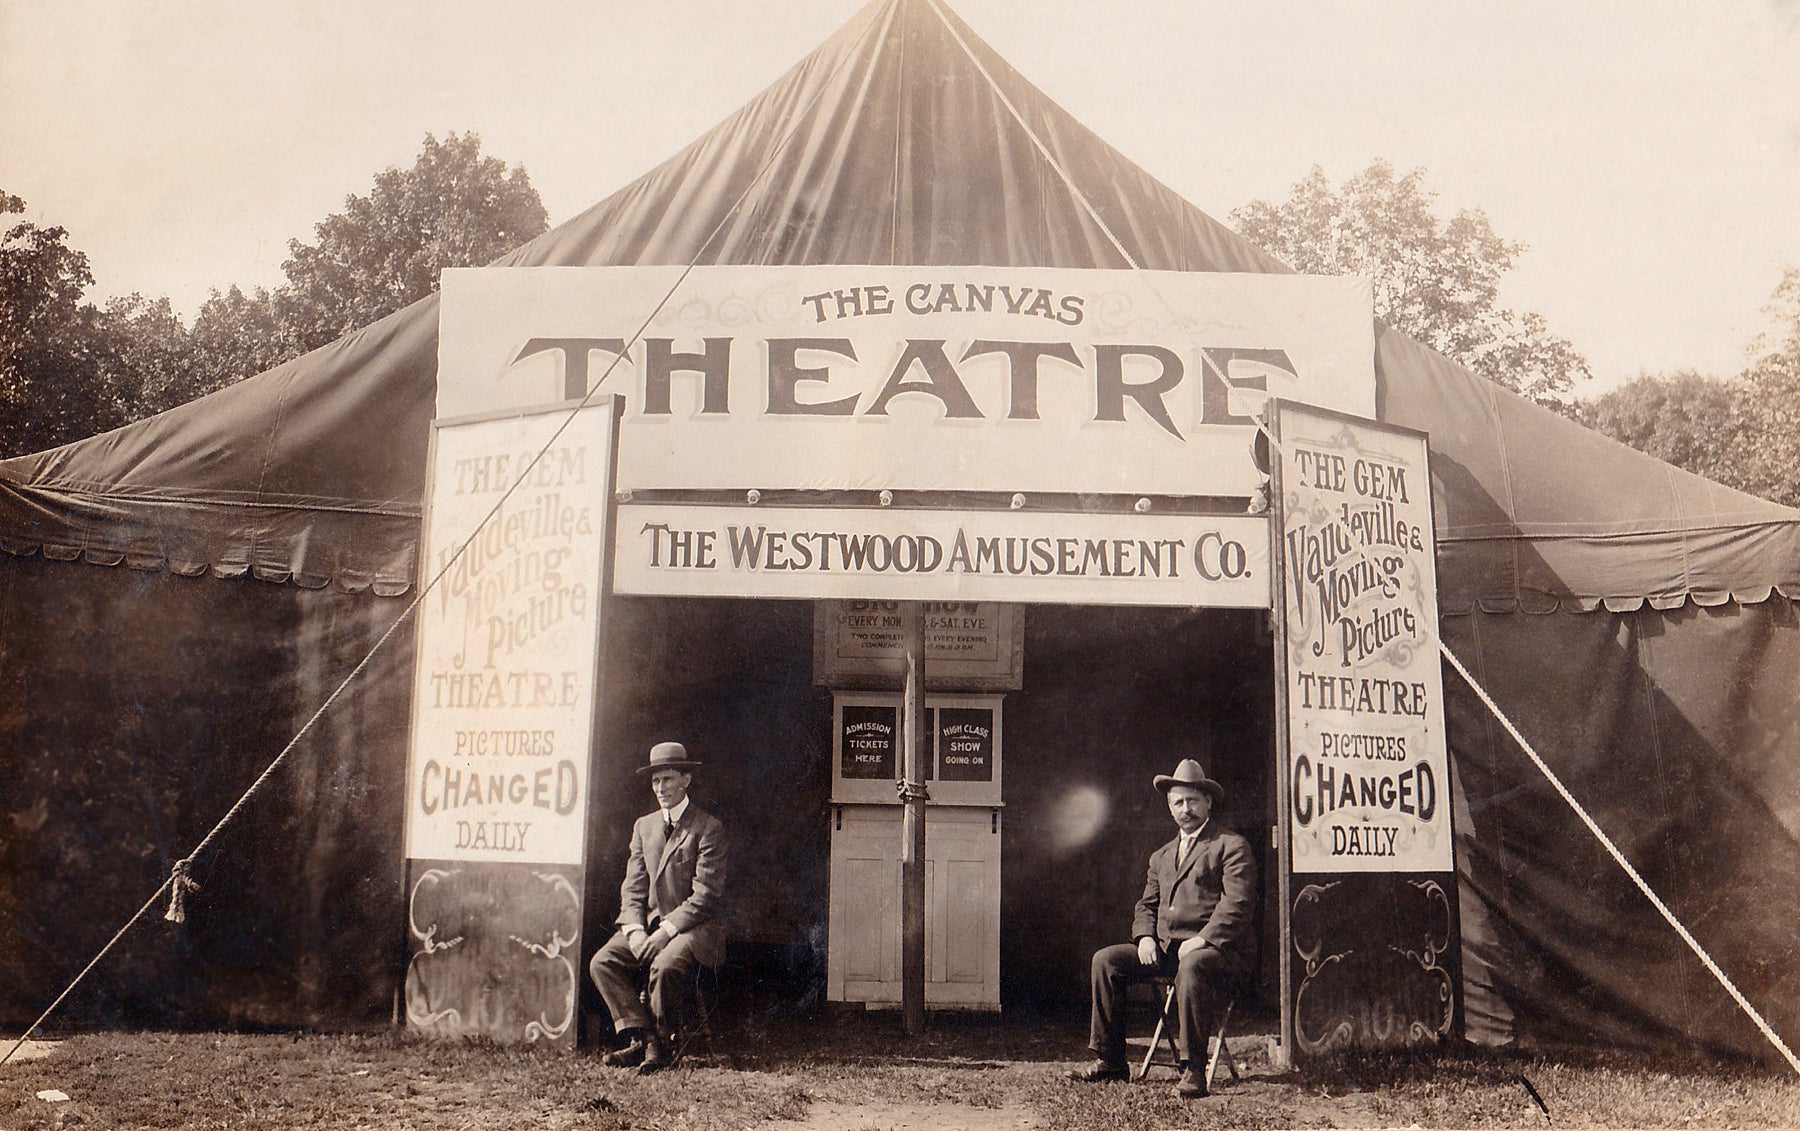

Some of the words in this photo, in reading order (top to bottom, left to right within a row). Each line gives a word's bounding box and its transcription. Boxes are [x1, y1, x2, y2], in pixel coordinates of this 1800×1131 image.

[801, 285, 895, 323] THE
[905, 283, 1085, 326] CANVAS
[510, 337, 1298, 442] THEATRE
[454, 454, 510, 495] THE
[516, 447, 587, 491] GEM
[1294, 449, 1347, 493] THE
[1353, 459, 1410, 504] GEM
[437, 493, 572, 625] Vaudeville
[640, 522, 717, 568] THE
[727, 526, 943, 572] WESTWOOD
[946, 528, 1185, 577] AMUSEMENT
[1287, 502, 1409, 628] Vaudeville
[453, 545, 571, 669] Moving
[483, 582, 588, 669] Picture
[848, 616, 879, 626] EVERY
[1313, 554, 1404, 657] Moving
[1339, 607, 1416, 667] Picture
[430, 670, 579, 711] THEATRE
[1298, 671, 1428, 718] THEATRE
[453, 730, 555, 757] PICTURES
[846, 722, 892, 736] ADMISSION
[849, 739, 889, 749] TICKETS
[942, 725, 963, 737] HIGH
[964, 724, 990, 738] CLASS
[950, 741, 982, 752] SHOW
[1320, 731, 1407, 762] PICTURES
[854, 754, 883, 763] HERE
[945, 756, 970, 765] GOING
[972, 756, 984, 765] ON
[420, 758, 579, 816] CHANGED
[1293, 753, 1437, 828] CHANGED
[455, 821, 533, 852] DAILY
[1331, 825, 1400, 857] DAILY
